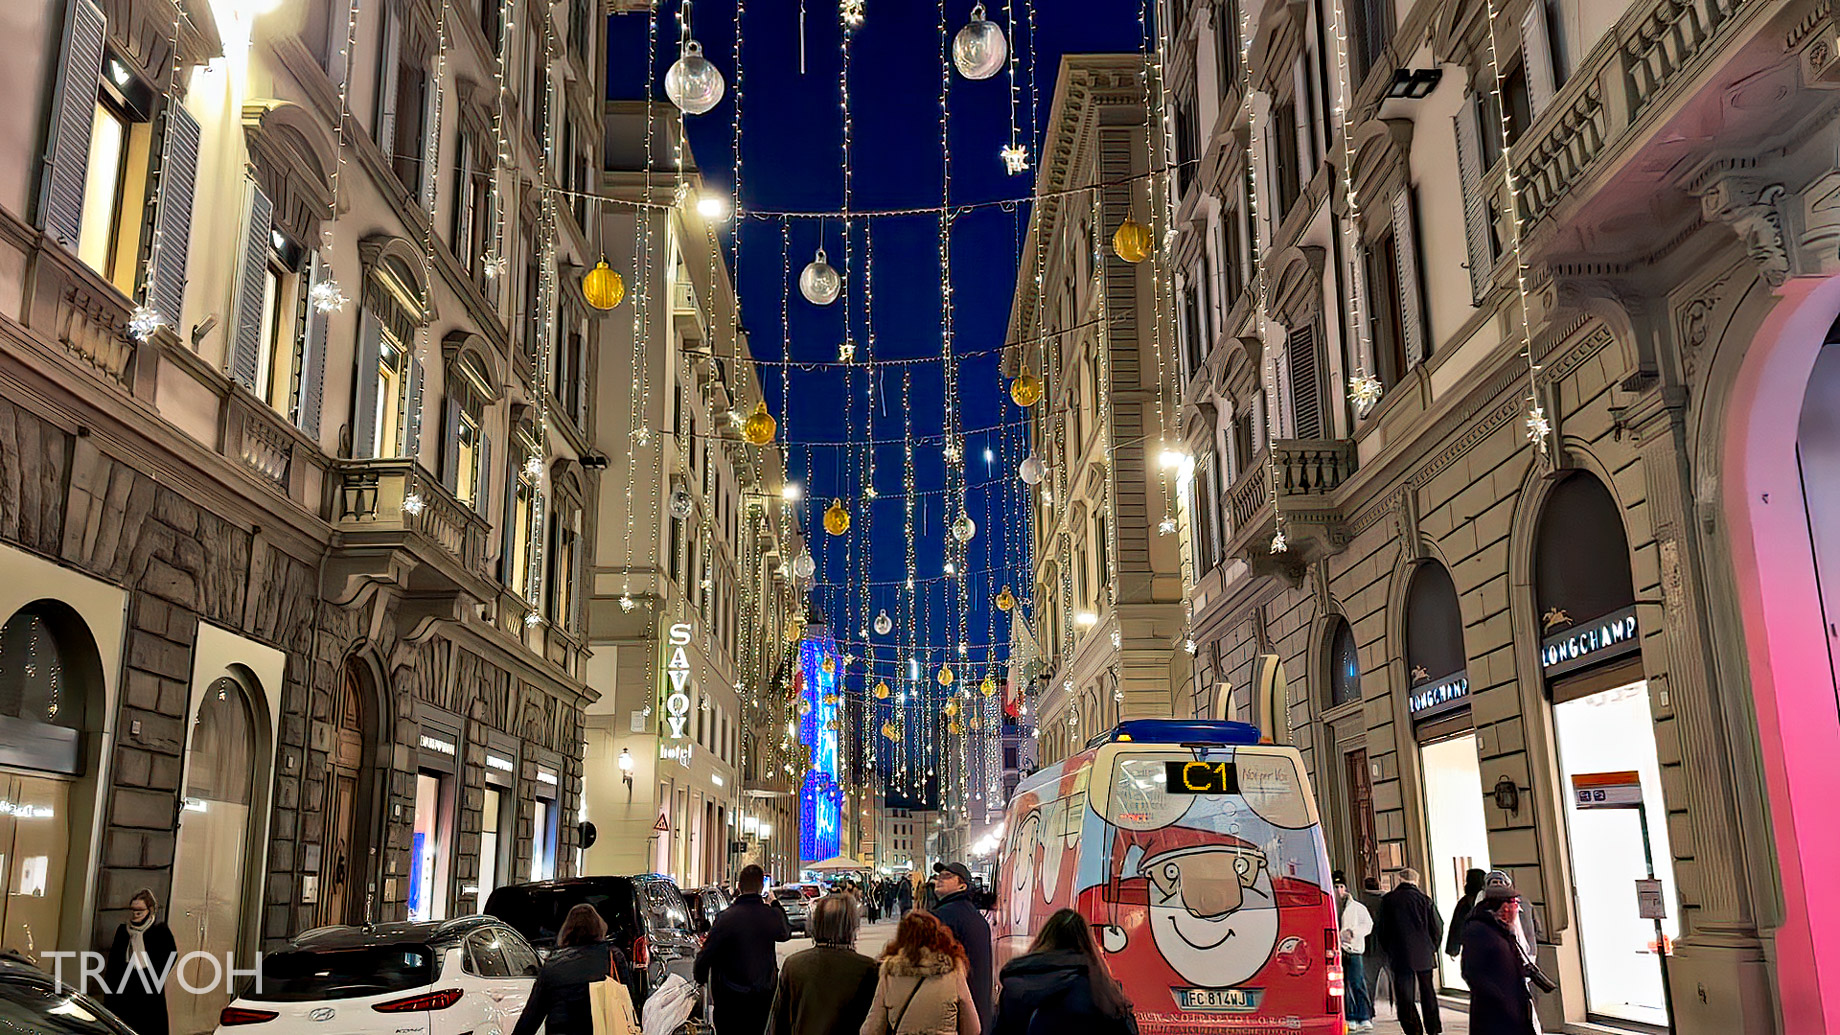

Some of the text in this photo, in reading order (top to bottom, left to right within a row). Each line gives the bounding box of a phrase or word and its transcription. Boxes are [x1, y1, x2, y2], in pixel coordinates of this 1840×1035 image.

[1542, 616, 1636, 667] LONGCHAMP
[667, 623, 691, 739] SAVOY
[1410, 678, 1468, 713] LONGCHAMP
[660, 743, 692, 760] hotel
[1183, 762, 1227, 791] C1
[1189, 993, 1204, 1006] FC
